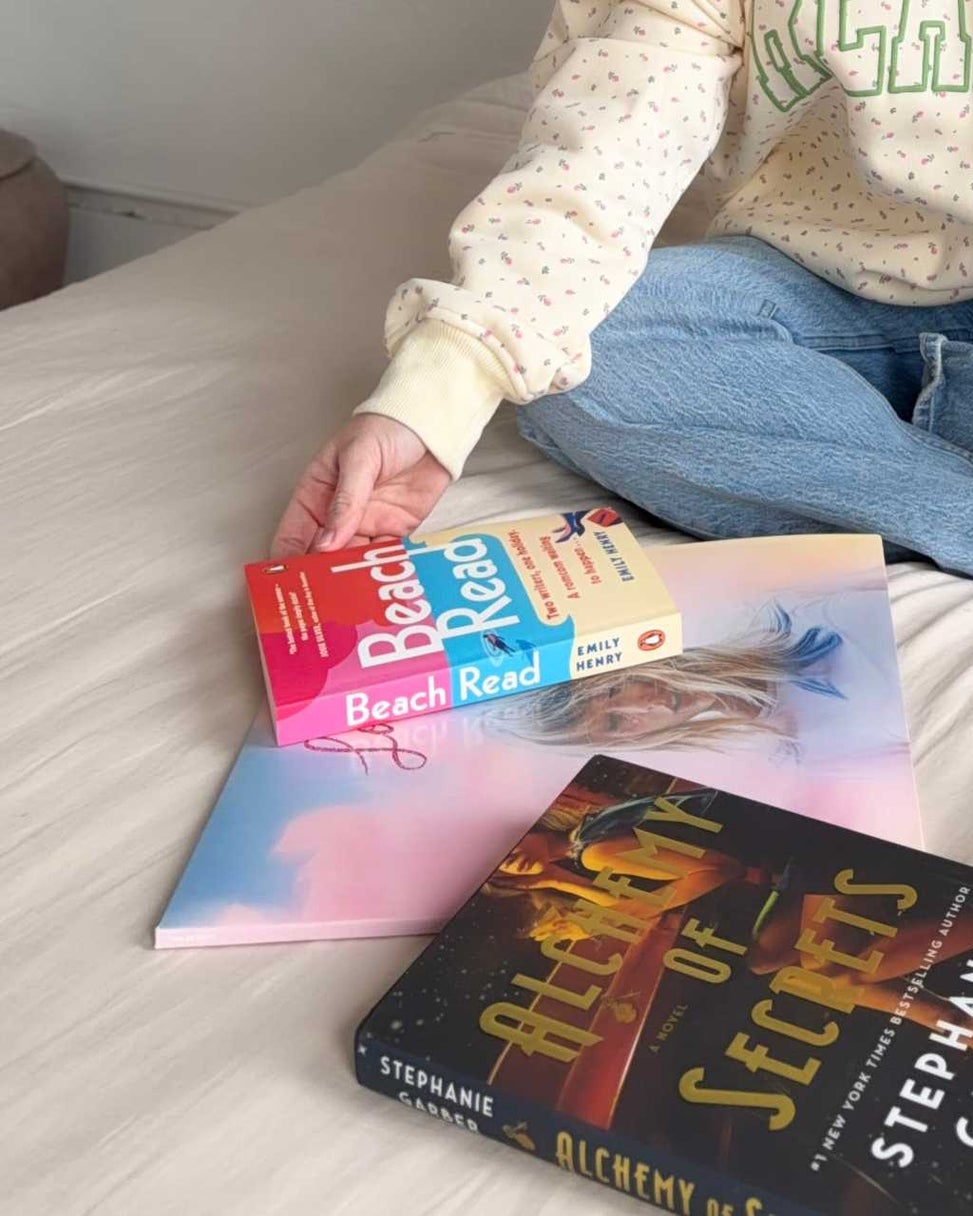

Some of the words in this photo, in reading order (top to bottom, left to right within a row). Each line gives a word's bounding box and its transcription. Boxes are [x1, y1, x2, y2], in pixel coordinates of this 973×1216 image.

[522, 556, 535, 570] one
[592, 531, 618, 554] HENRY
[553, 560, 576, 591] romcom
[590, 575, 602, 585] to
[610, 556, 635, 582] EMILY
[331, 544, 446, 669] Beach
[409, 538, 521, 640] Read
[544, 601, 559, 620] Two
[576, 652, 622, 672] HENRY
[577, 637, 620, 657] EMILY
[345, 676, 446, 726] Beach
[459, 651, 541, 701] Read
[479, 796, 724, 1063] ALCHEMY
[663, 918, 747, 984] OF
[678, 868, 918, 1131] SECRETS
[649, 1042, 660, 1053] A
[655, 1003, 688, 1042] NOVEL
[810, 1153, 828, 1172] #1
[822, 1114, 847, 1151] NEW
[842, 1071, 872, 1111] YORK
[865, 1027, 896, 1068] TIMES
[890, 939, 943, 1025] BESTSELLING
[938, 886, 971, 936] AUTHOR
[380, 1055, 494, 1118] STEPHANIE
[556, 1131, 695, 1216] ALCHEMY
